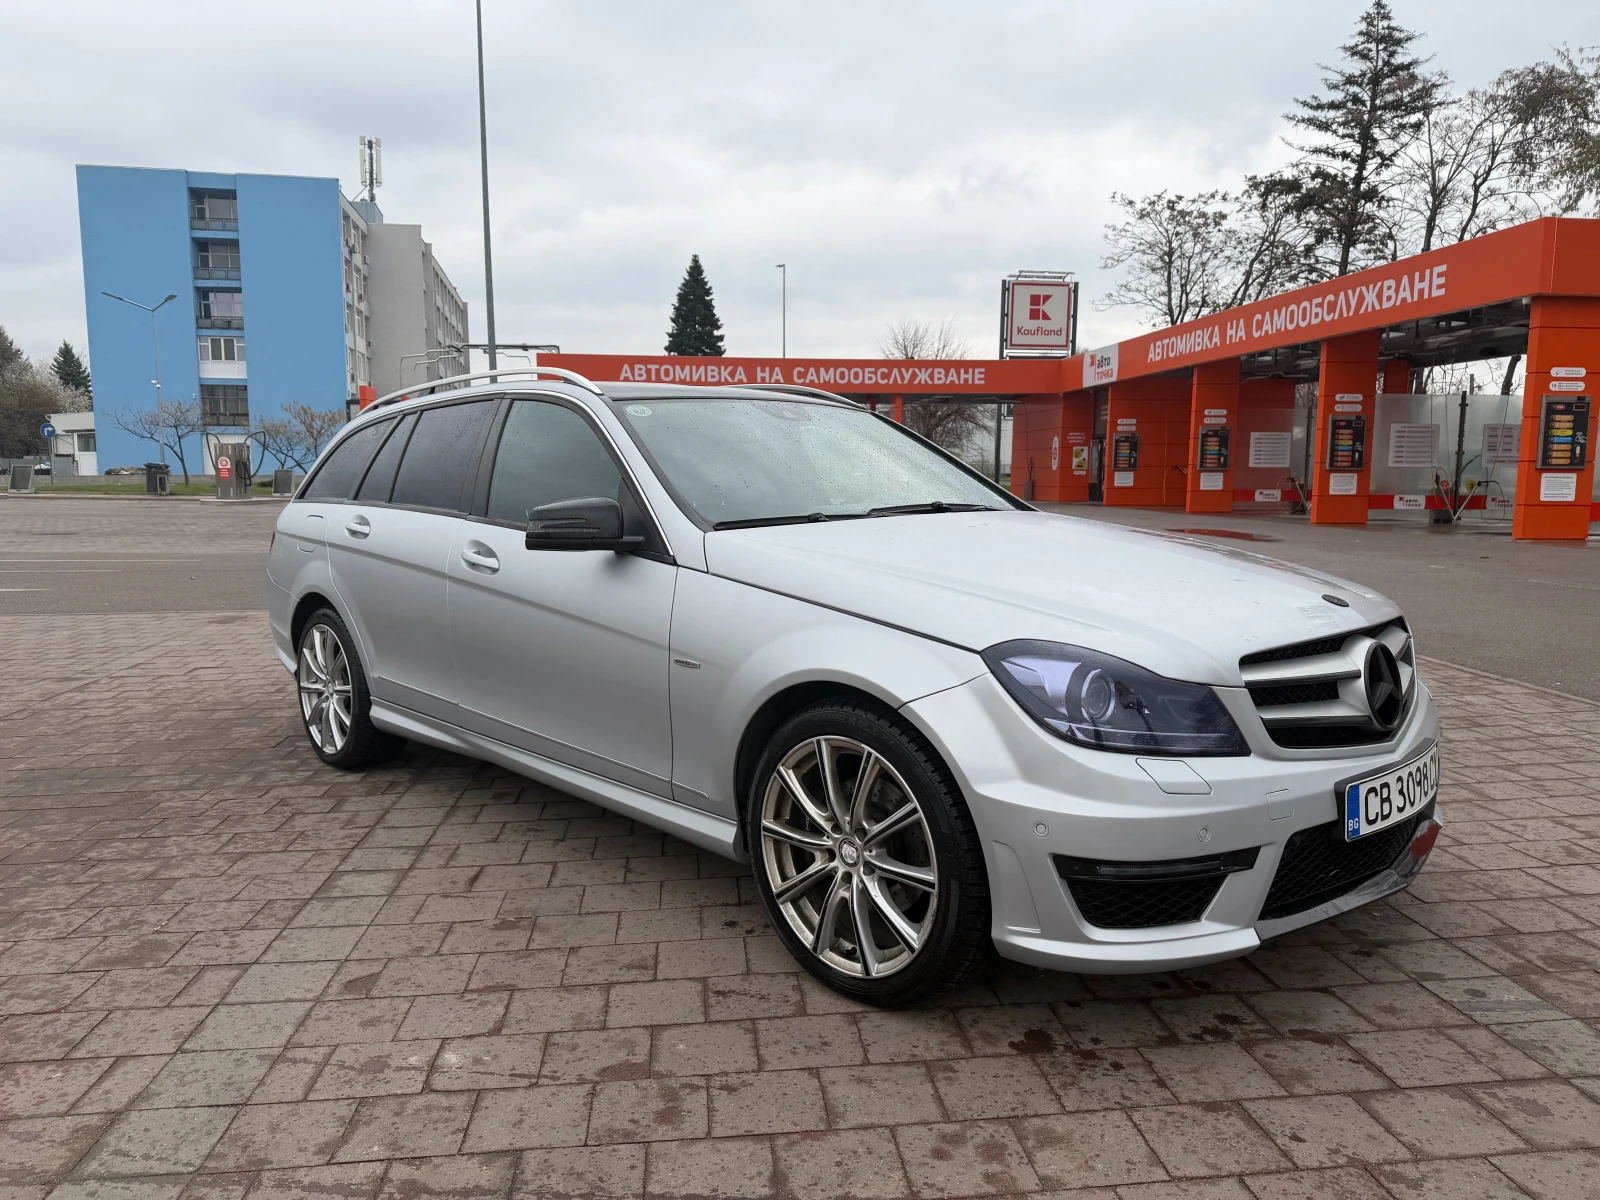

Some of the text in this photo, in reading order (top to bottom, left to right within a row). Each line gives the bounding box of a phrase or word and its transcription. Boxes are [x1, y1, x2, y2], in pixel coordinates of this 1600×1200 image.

[1147, 264, 1448, 363] АВТОМИВКА НА САМООБСЛУЖВАНЕ
[1017, 326, 1063, 337] Kaufland
[619, 363, 986, 385] АВТОМИВКА НА САМООБСЛУЖВАНЕ
[1364, 781, 1393, 826] CB
[1395, 761, 1428, 813] 3098
[1348, 818, 1359, 831] BG
